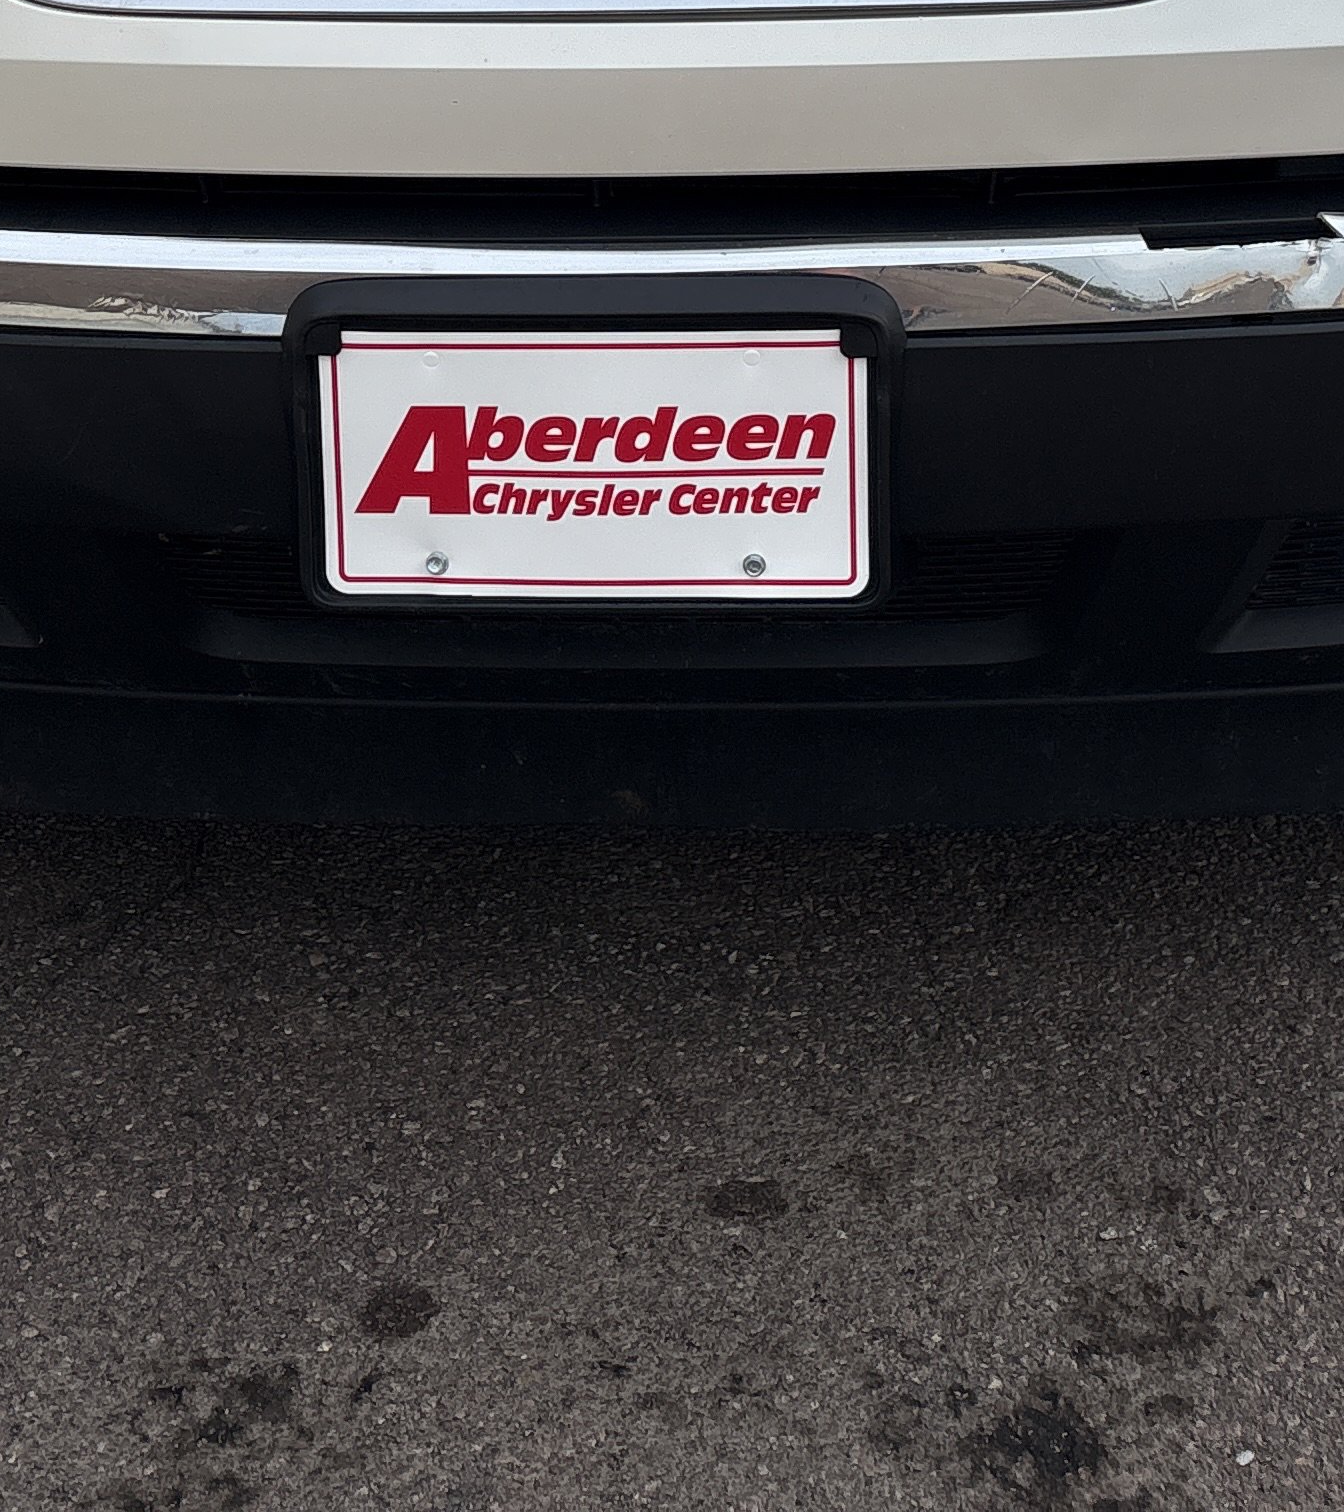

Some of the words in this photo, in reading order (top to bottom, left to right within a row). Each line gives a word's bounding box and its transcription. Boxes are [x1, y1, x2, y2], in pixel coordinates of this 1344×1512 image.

[354, 405, 837, 515] Aberdeen
[472, 481, 661, 522] Chrysler
[668, 482, 821, 516] Center
